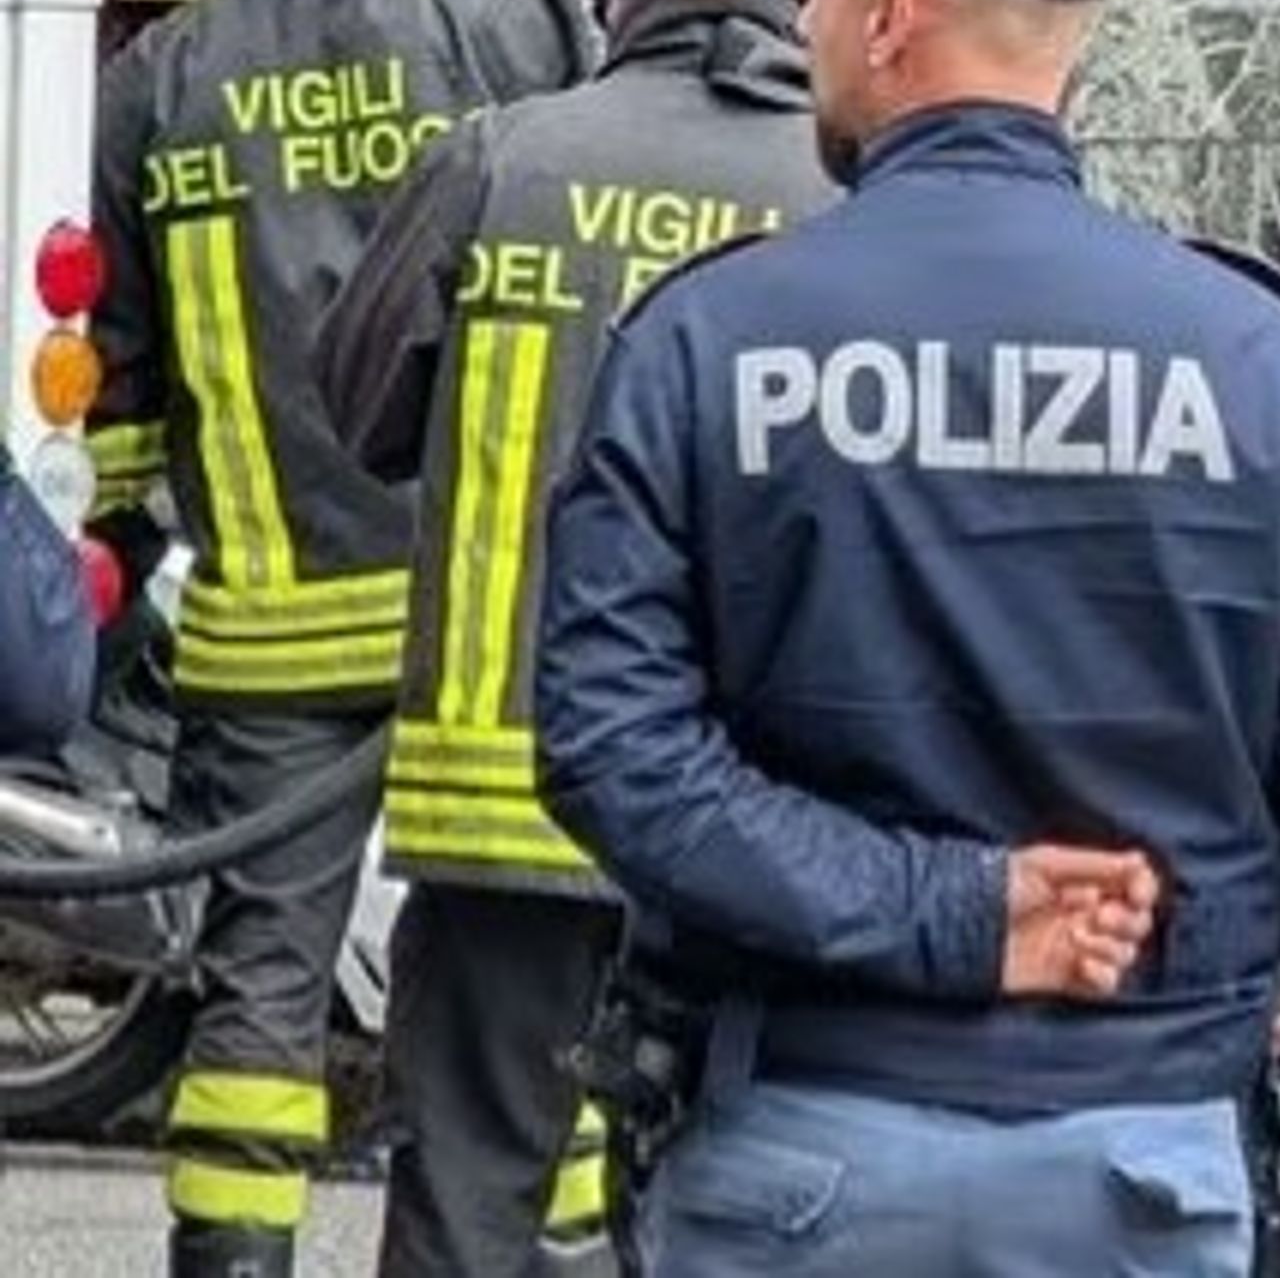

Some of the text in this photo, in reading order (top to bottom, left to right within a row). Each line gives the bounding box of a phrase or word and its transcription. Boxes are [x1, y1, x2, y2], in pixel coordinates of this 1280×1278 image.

[221, 58, 403, 133] VIGILI
[282, 106, 480, 194] FUO
[736, 340, 1235, 481] POLIZIA
